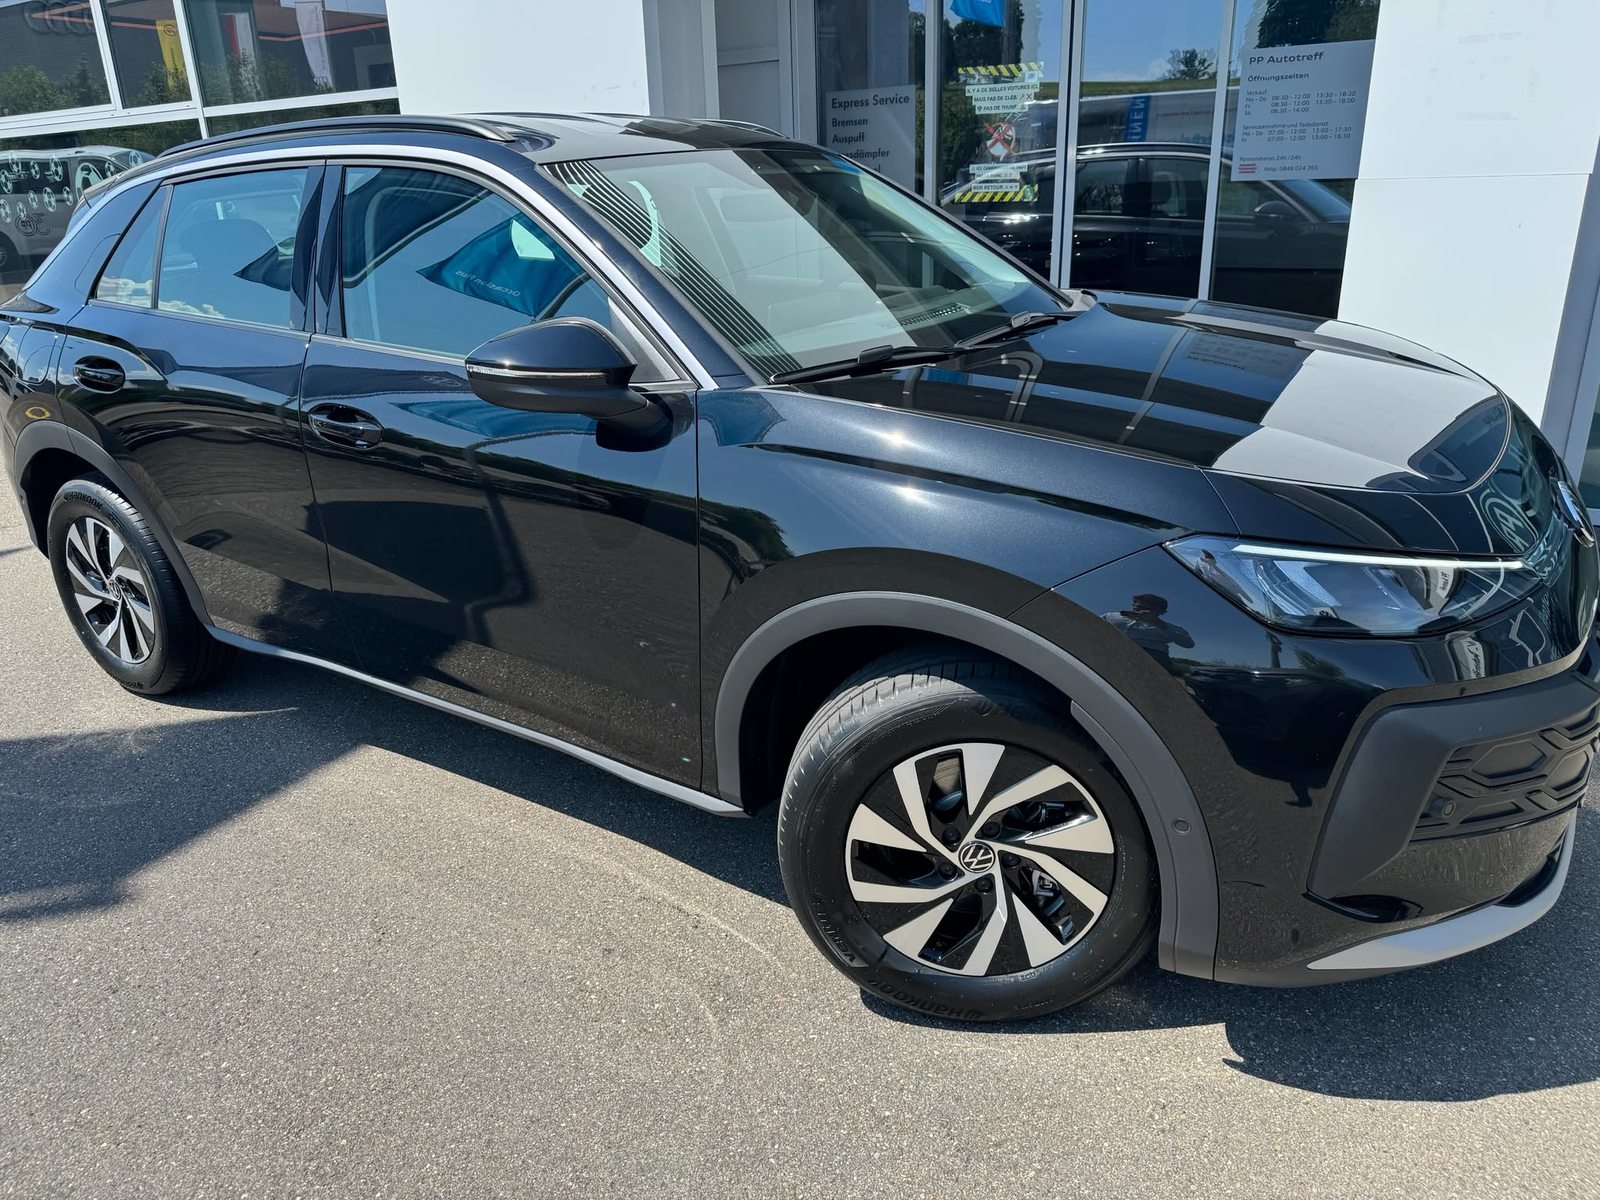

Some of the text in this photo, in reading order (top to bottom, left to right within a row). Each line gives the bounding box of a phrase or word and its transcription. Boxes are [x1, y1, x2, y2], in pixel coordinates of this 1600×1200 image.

[1249, 52, 1324, 65] PP Autotreff
[1247, 72, 1310, 82] Öffnungszeiten
[832, 94, 910, 110] Express Service
[832, 118, 868, 128] Bremsen
[832, 132, 865, 144] Auspuff
